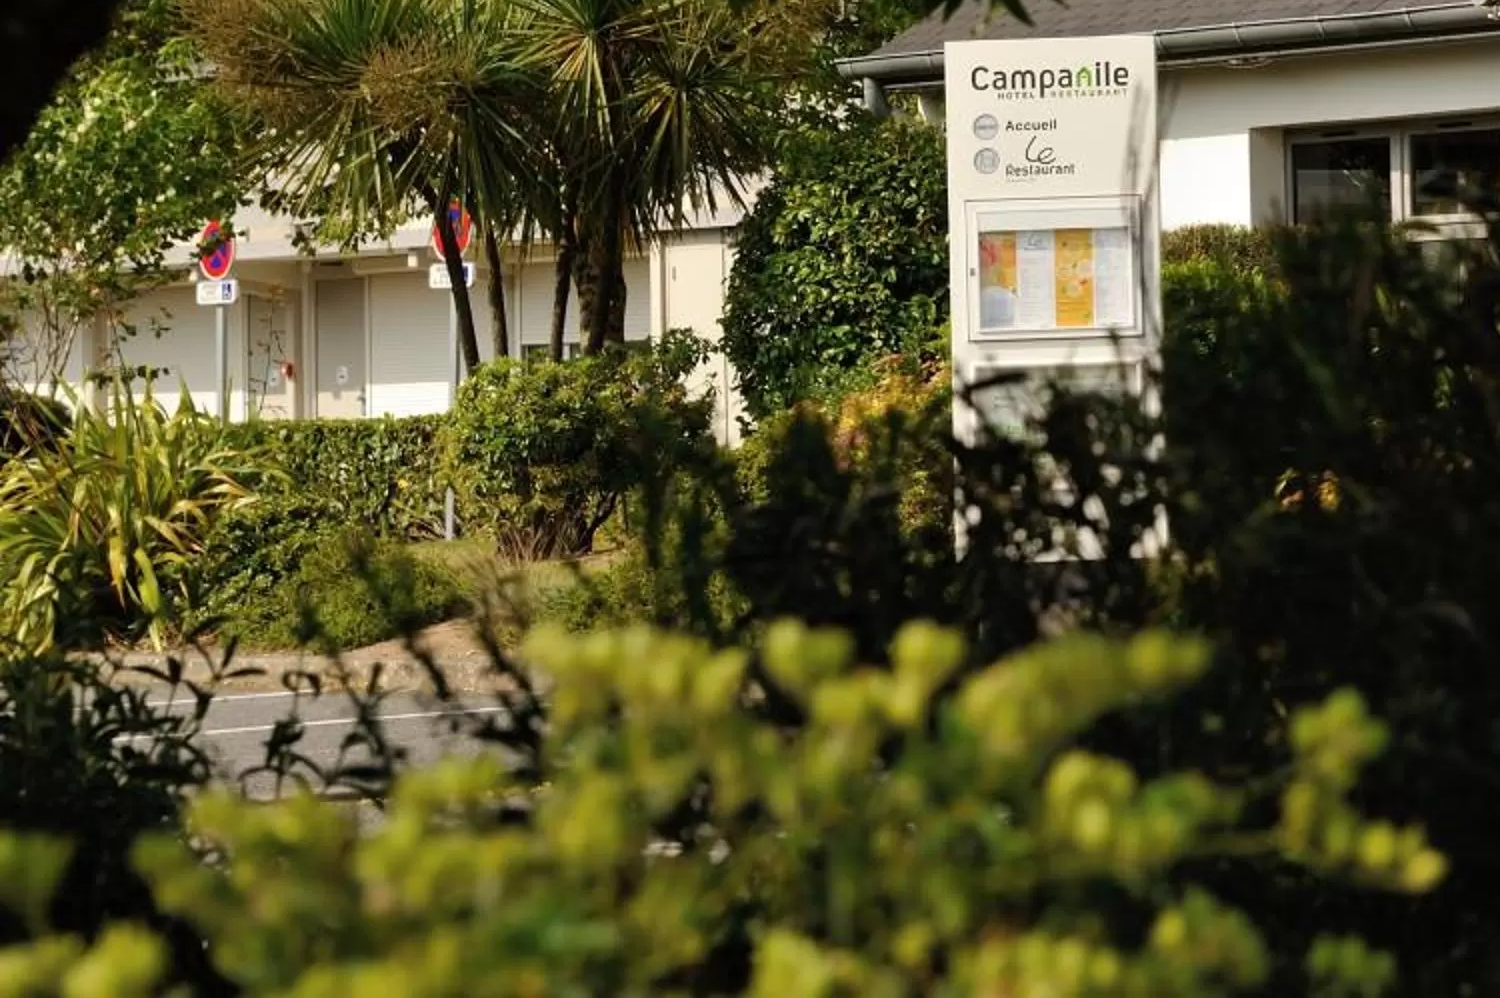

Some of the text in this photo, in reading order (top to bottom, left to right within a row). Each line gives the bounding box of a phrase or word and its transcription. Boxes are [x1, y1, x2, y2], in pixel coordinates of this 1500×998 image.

[971, 62, 1129, 98] Campanile
[1005, 118, 1057, 132] Accueil
[1025, 135, 1056, 164] Le
[1005, 163, 1075, 177] Restaurant
